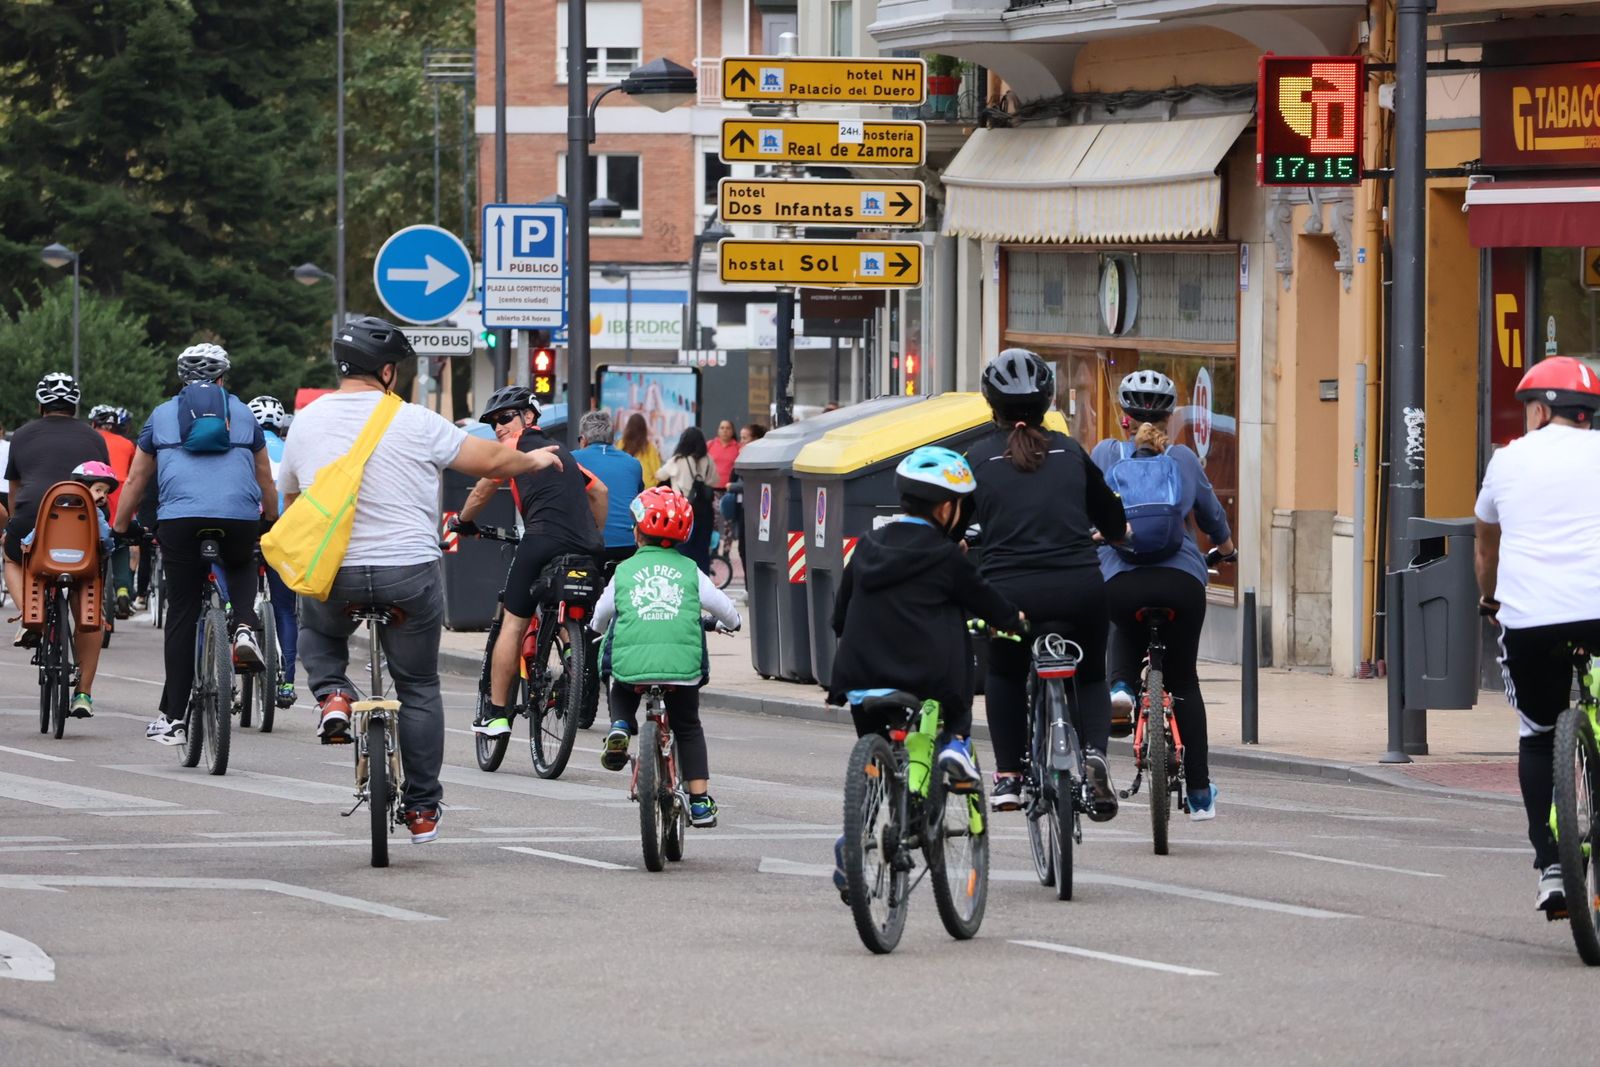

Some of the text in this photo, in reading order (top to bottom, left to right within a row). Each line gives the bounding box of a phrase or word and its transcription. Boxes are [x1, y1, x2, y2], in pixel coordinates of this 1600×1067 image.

[847, 69, 916, 81] hotel NH
[789, 84, 915, 96] Palacio del Duero
[863, 130, 914, 141] hostería
[788, 142, 914, 158] Real de Zamora
[1275, 157, 1353, 178] 17:15
[729, 187, 766, 198] hotel
[729, 202, 854, 217] Dos Infantas
[520, 219, 548, 254] P
[509, 261, 559, 273] PÚBLICO
[728, 255, 839, 272] hostal Sol
[443, 335, 469, 347] BUS
[632, 564, 683, 583] IVY PREP
[642, 612, 674, 621] ACADEMY
